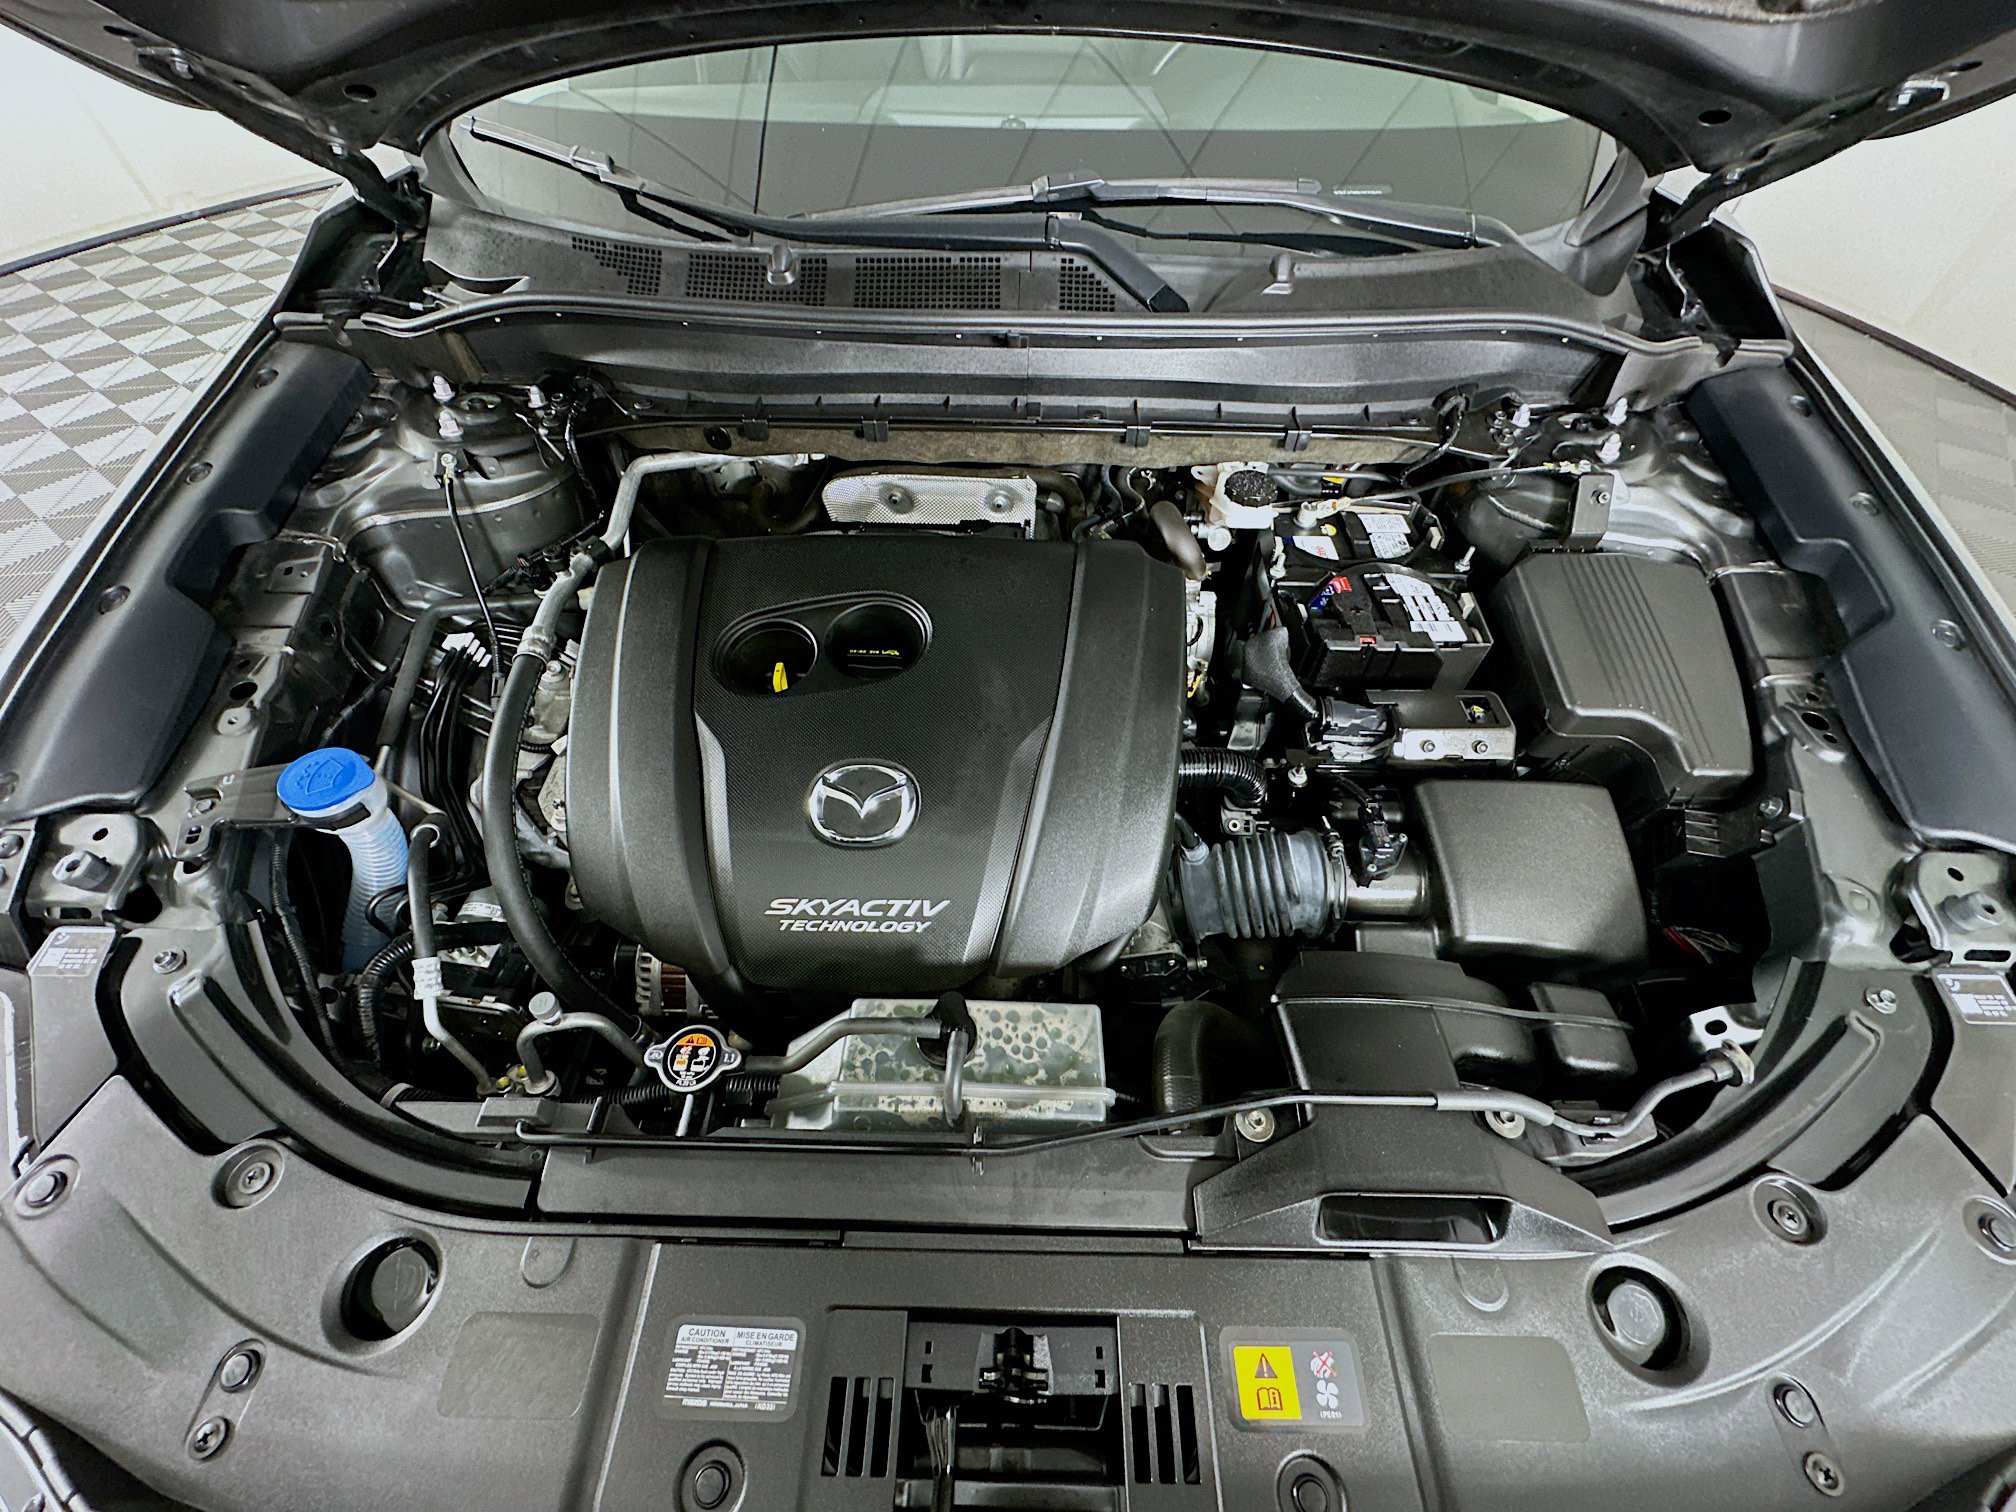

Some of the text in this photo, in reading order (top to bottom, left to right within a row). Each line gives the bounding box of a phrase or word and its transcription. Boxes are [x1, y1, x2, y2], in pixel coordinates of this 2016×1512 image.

[764, 898, 950, 917] SKYACTIV
[779, 919, 932, 933] TECHNOLOGY
[688, 1328, 726, 1338] CAUTION
[736, 1331, 795, 1341] MISE EN GARDE
